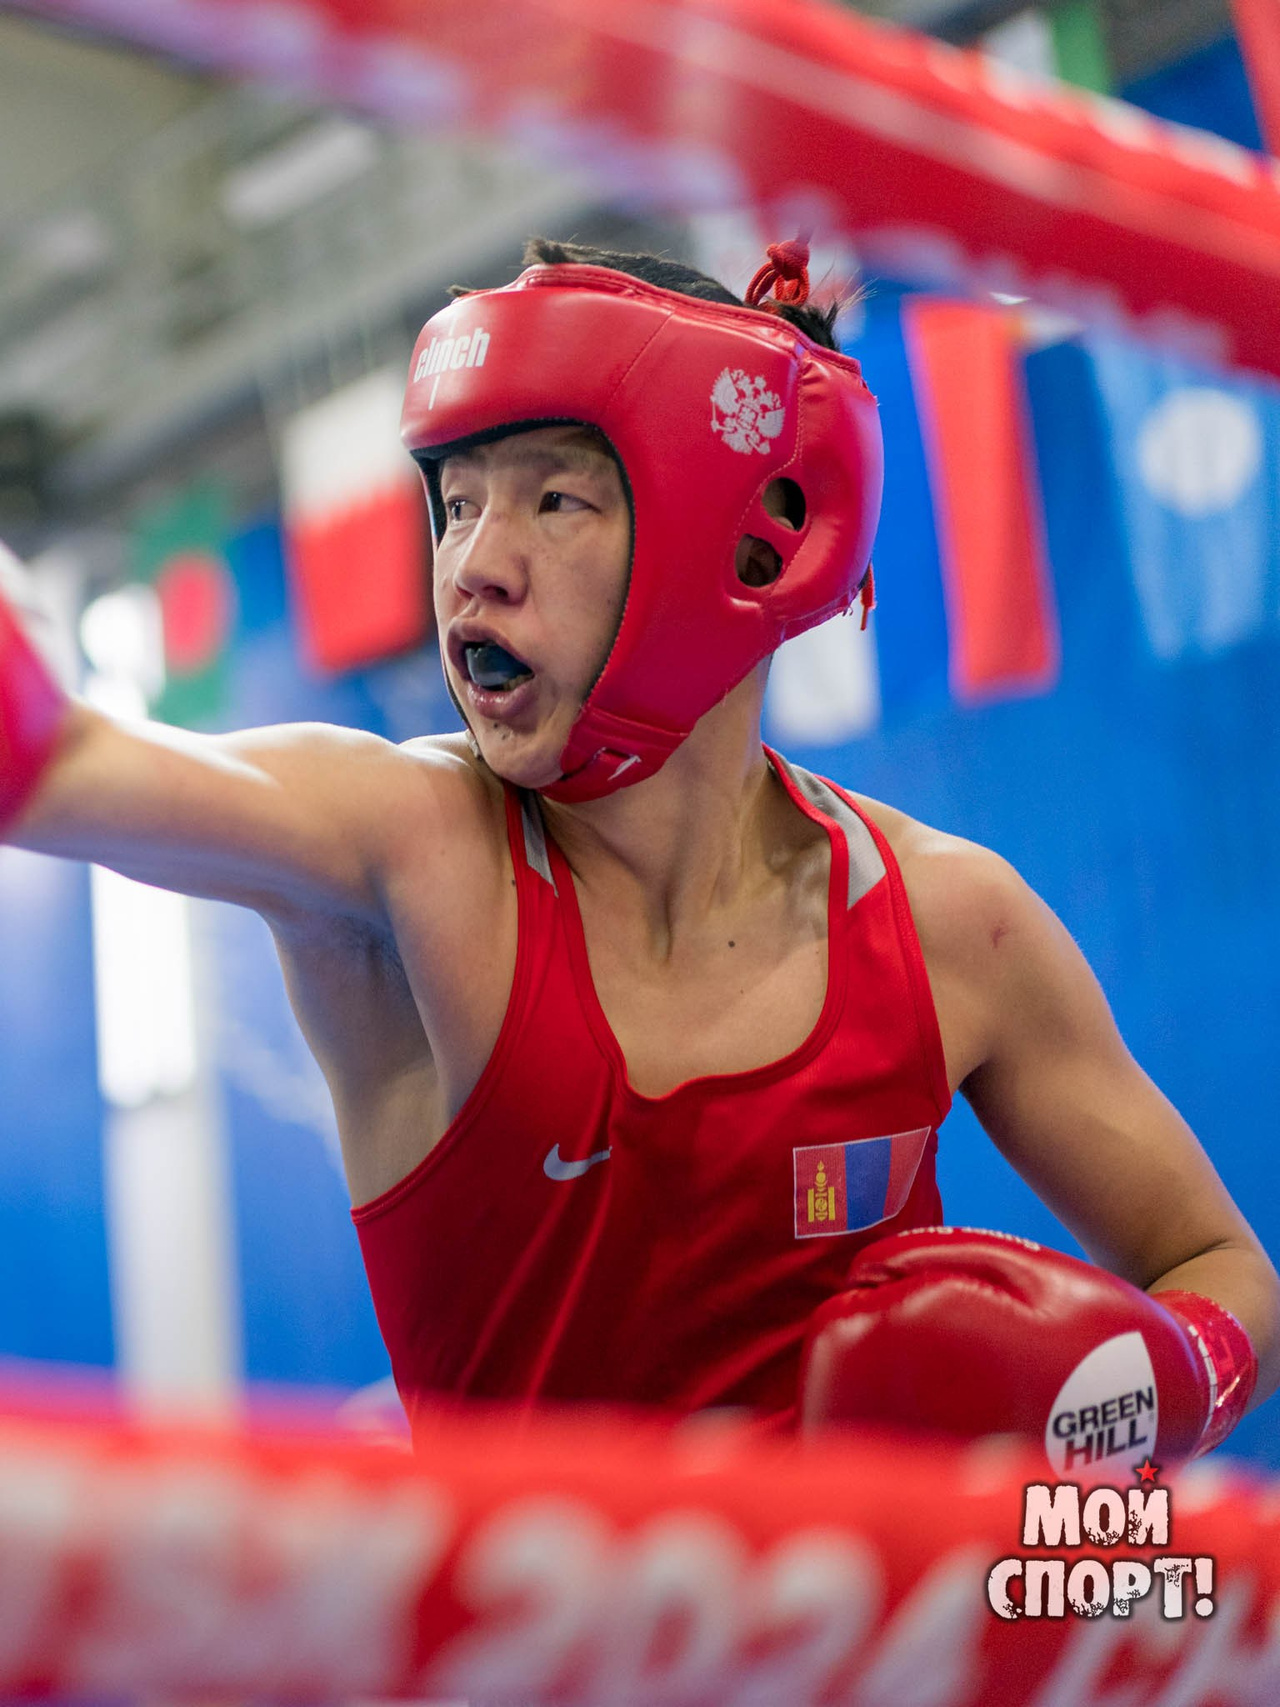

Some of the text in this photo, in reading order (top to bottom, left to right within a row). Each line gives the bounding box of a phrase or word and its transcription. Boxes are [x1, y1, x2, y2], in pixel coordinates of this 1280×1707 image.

[413, 327, 490, 384] clinch
[1053, 1386, 1154, 1439] GREEN
[1064, 1419, 1148, 1472] HILL
[417, 1490, 1000, 1707] 2024
